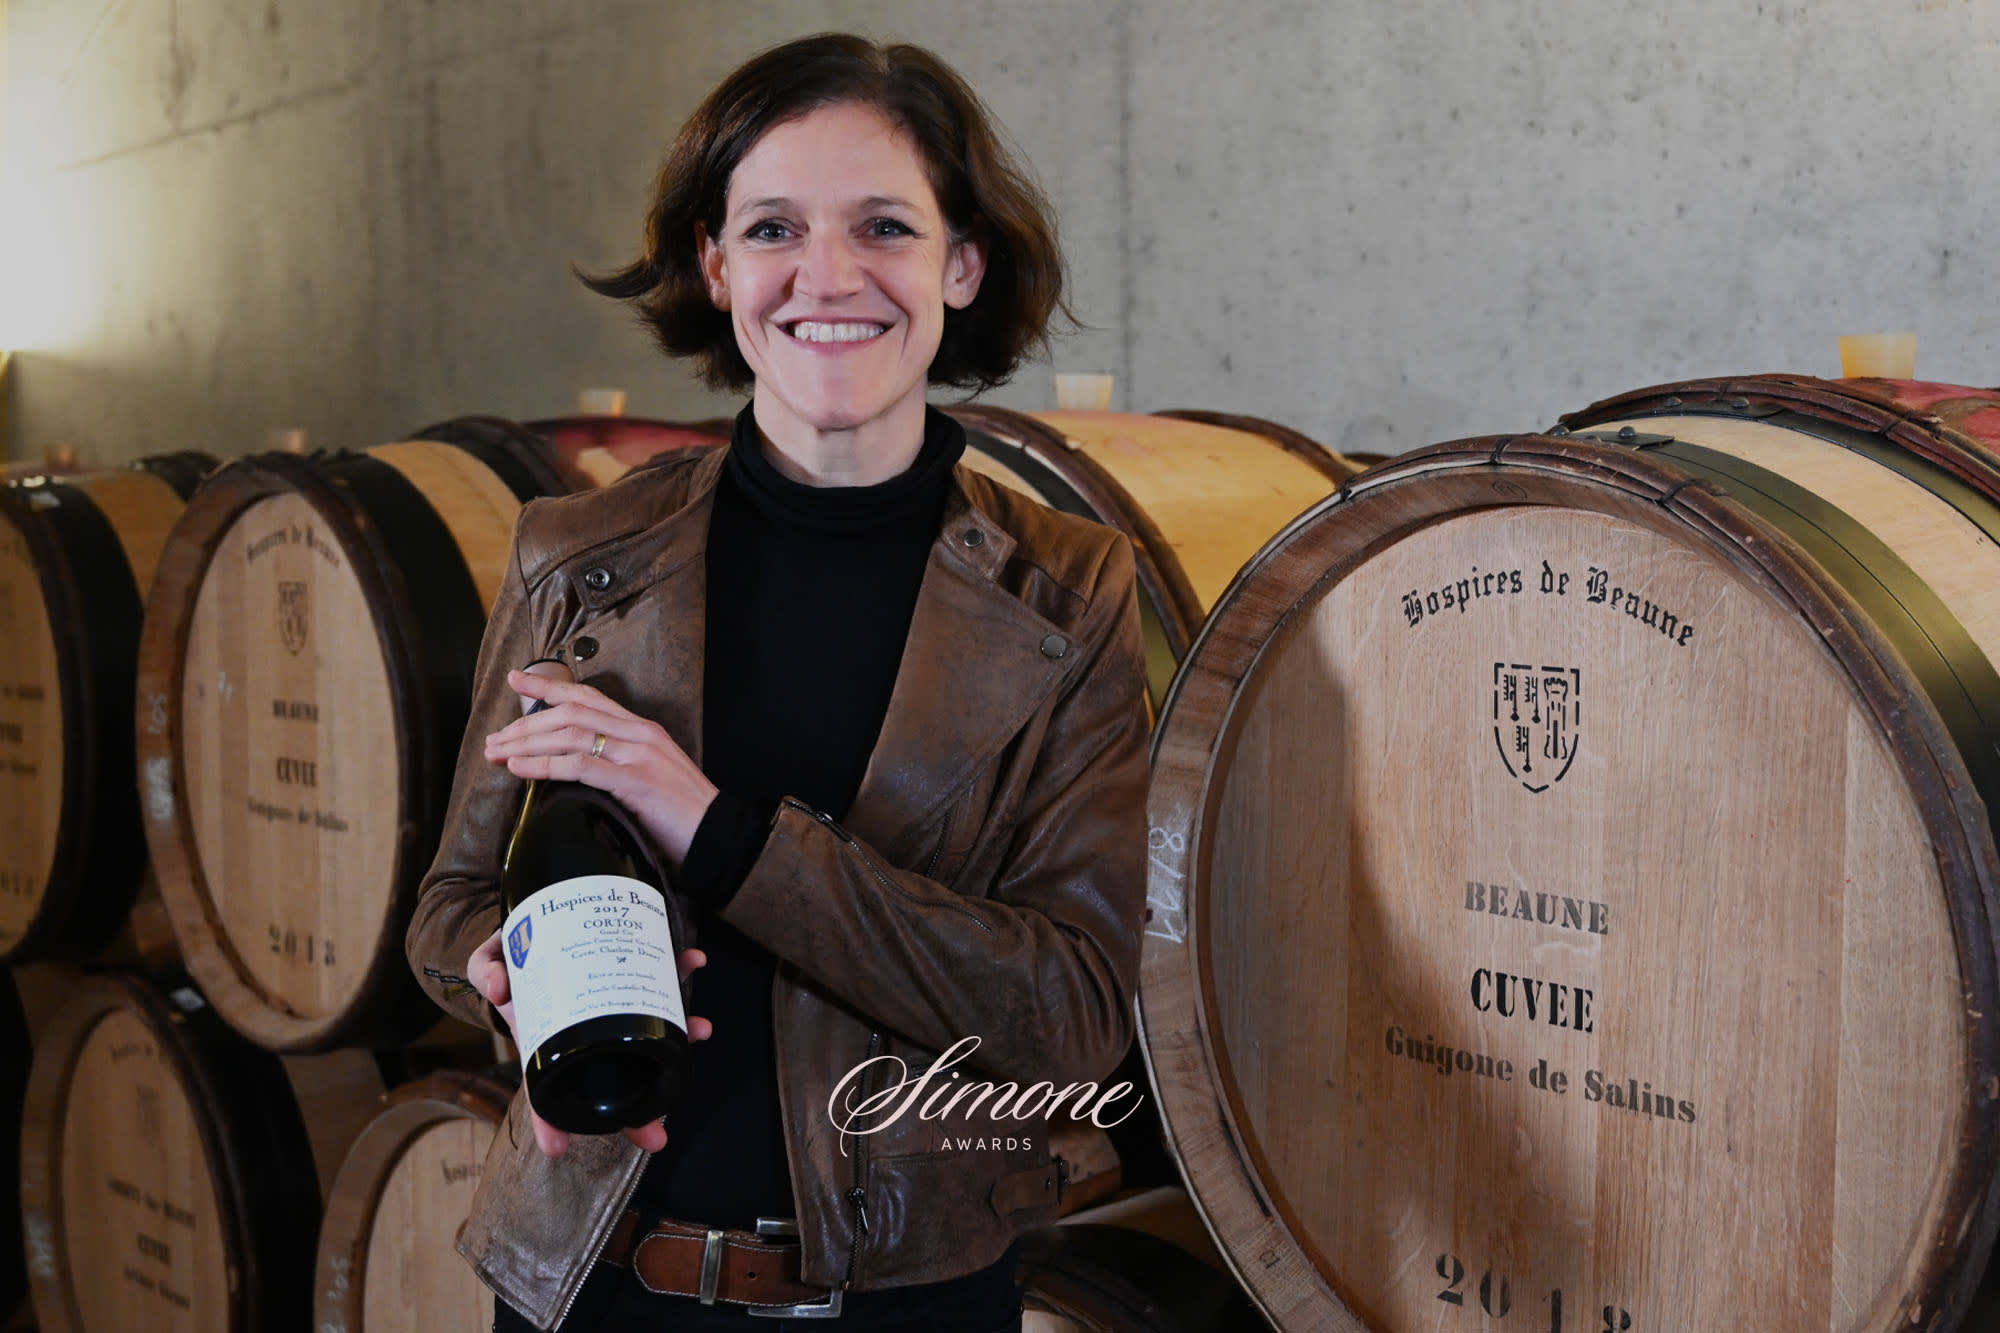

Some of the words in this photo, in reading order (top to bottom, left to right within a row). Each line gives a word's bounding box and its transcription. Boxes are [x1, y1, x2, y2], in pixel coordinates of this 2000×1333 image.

[1400, 565, 1523, 629] Hospices
[1539, 559, 1570, 596] de
[1586, 565, 1694, 647] Beaune
[540, 892, 603, 916] Hospices
[607, 887, 624, 902] de
[583, 918, 643, 930] CORTON
[592, 905, 631, 918] 2017
[1463, 880, 1610, 936] BEAUNE
[1470, 967, 1594, 1033] CUVEE
[1384, 1024, 1514, 1082] Guigone
[1528, 1058, 1569, 1095] de
[1584, 1069, 1697, 1124] Salins
